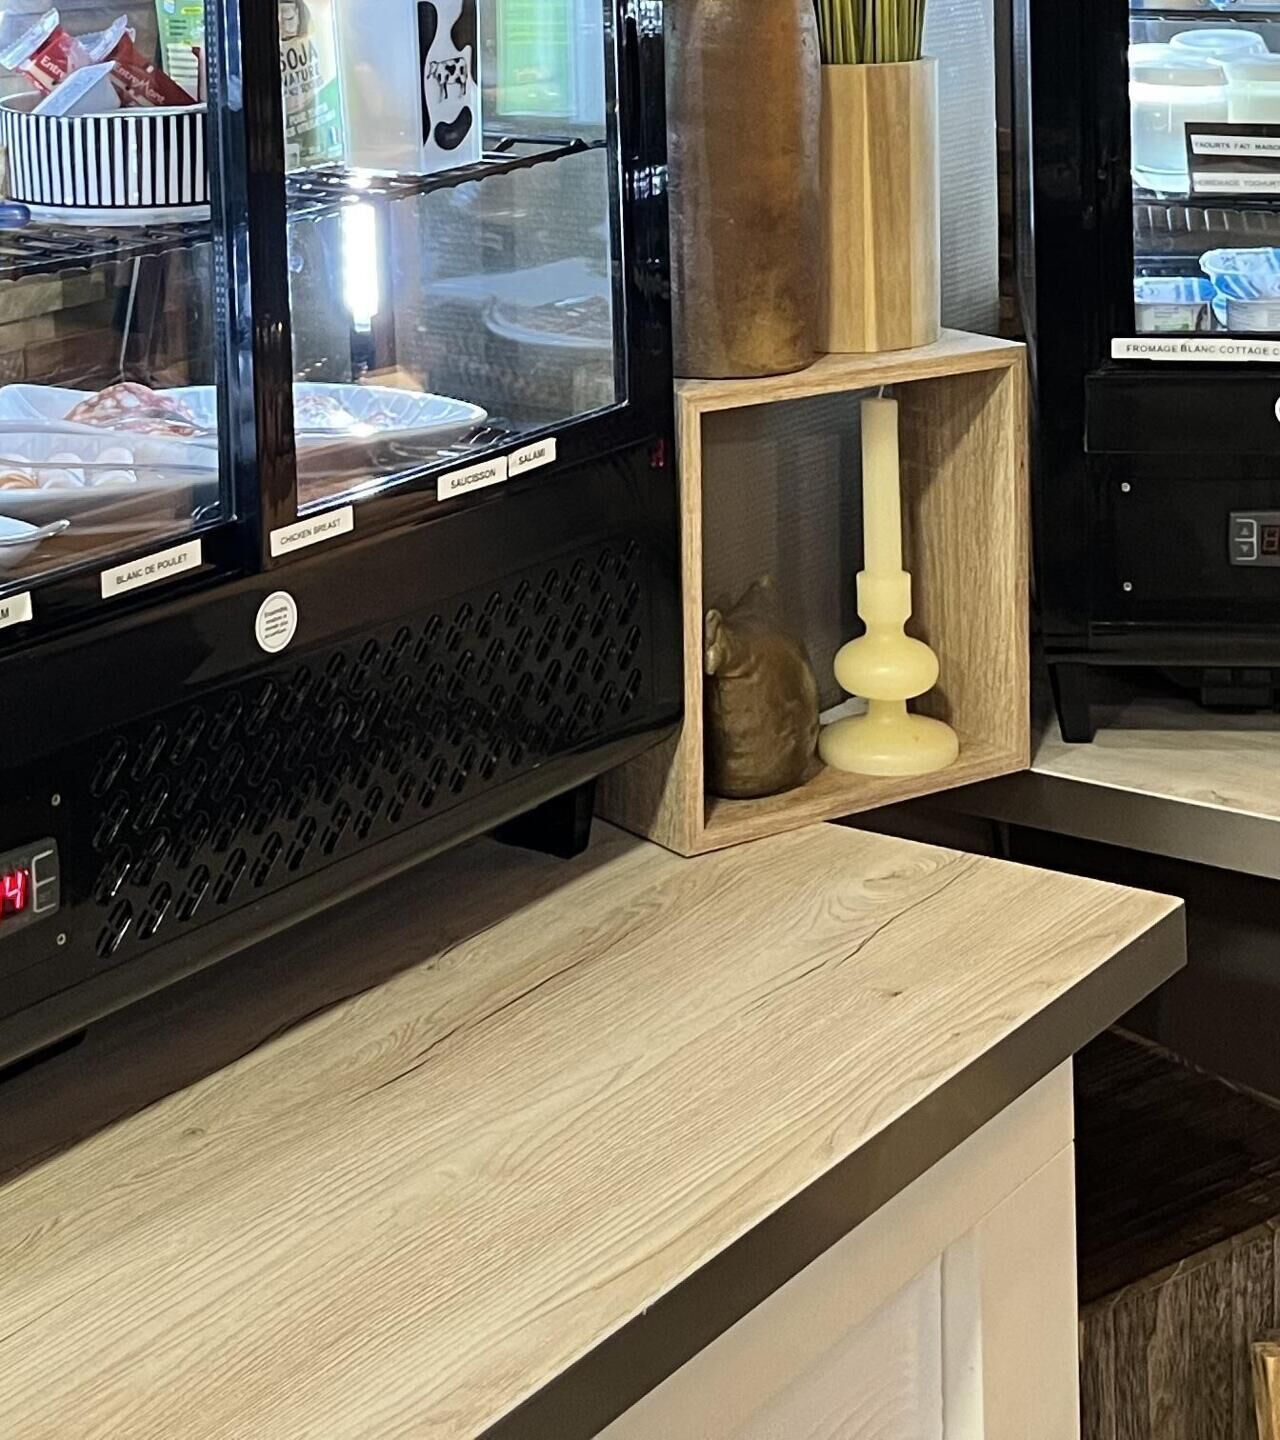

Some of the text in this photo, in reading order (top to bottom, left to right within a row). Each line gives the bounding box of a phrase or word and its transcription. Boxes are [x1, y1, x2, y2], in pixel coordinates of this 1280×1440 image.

[1126, 344, 1270, 356] FROMAGE BLANC COTTAGE
[517, 447, 547, 466] SALAMI
[450, 467, 497, 491] SAUCISSON
[279, 517, 342, 546] CHICKEN BREAST
[157, 552, 188, 571] POULET
